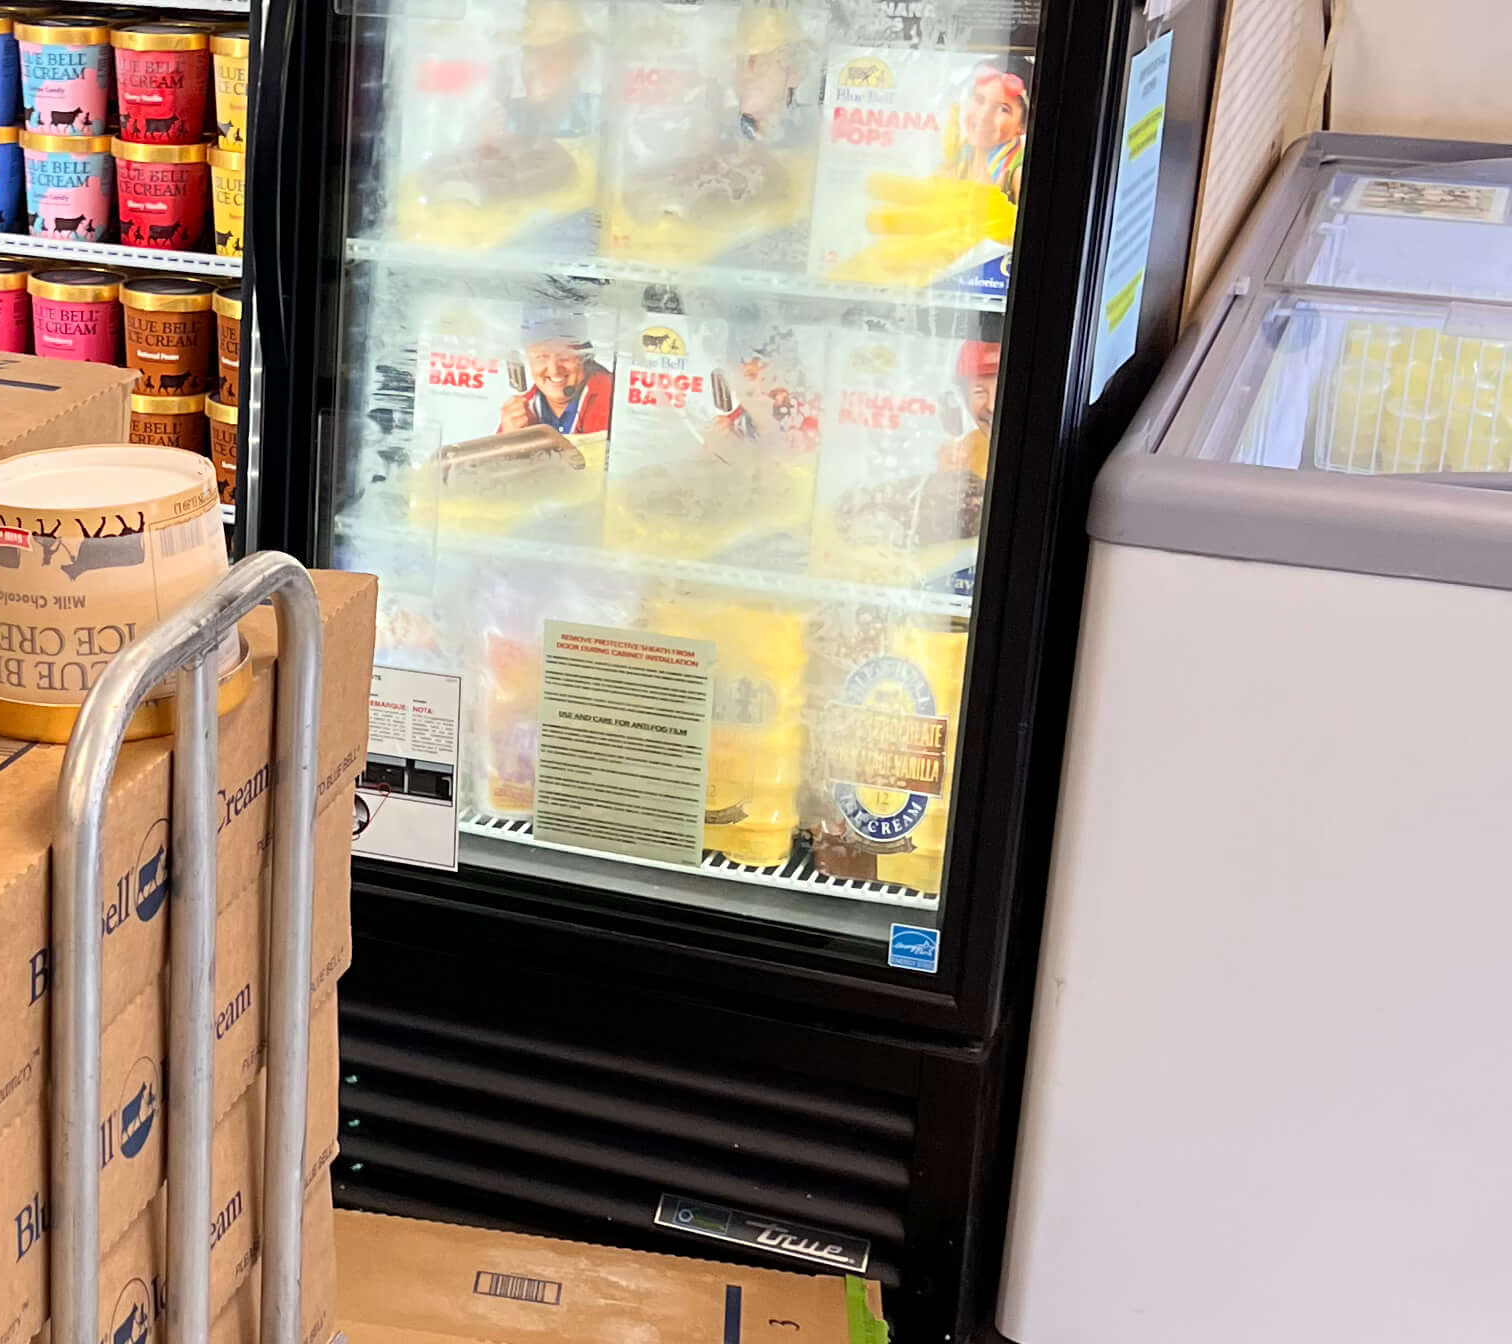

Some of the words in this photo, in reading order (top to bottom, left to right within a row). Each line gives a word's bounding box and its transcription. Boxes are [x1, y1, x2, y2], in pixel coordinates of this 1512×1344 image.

[34, 67, 86, 80] CREAM
[834, 107, 939, 131] BANANA
[133, 182, 187, 197] CREAM
[60, 309, 98, 323] BELL
[45, 322, 97, 336] CREAM
[145, 334, 198, 348] CREAM
[428, 369, 485, 390] BARS
[630, 370, 705, 393] FUDGE
[143, 421, 182, 435] BELL
[53, 594, 86, 610] Milk
[73, 622, 137, 656] ICE
[558, 711, 573, 719] USE
[574, 713, 593, 722] AND
[593, 715, 613, 724] CARE
[615, 718, 630, 727] FOR
[866, 801, 922, 836] CREAM
[744, 1220, 857, 1264] true
